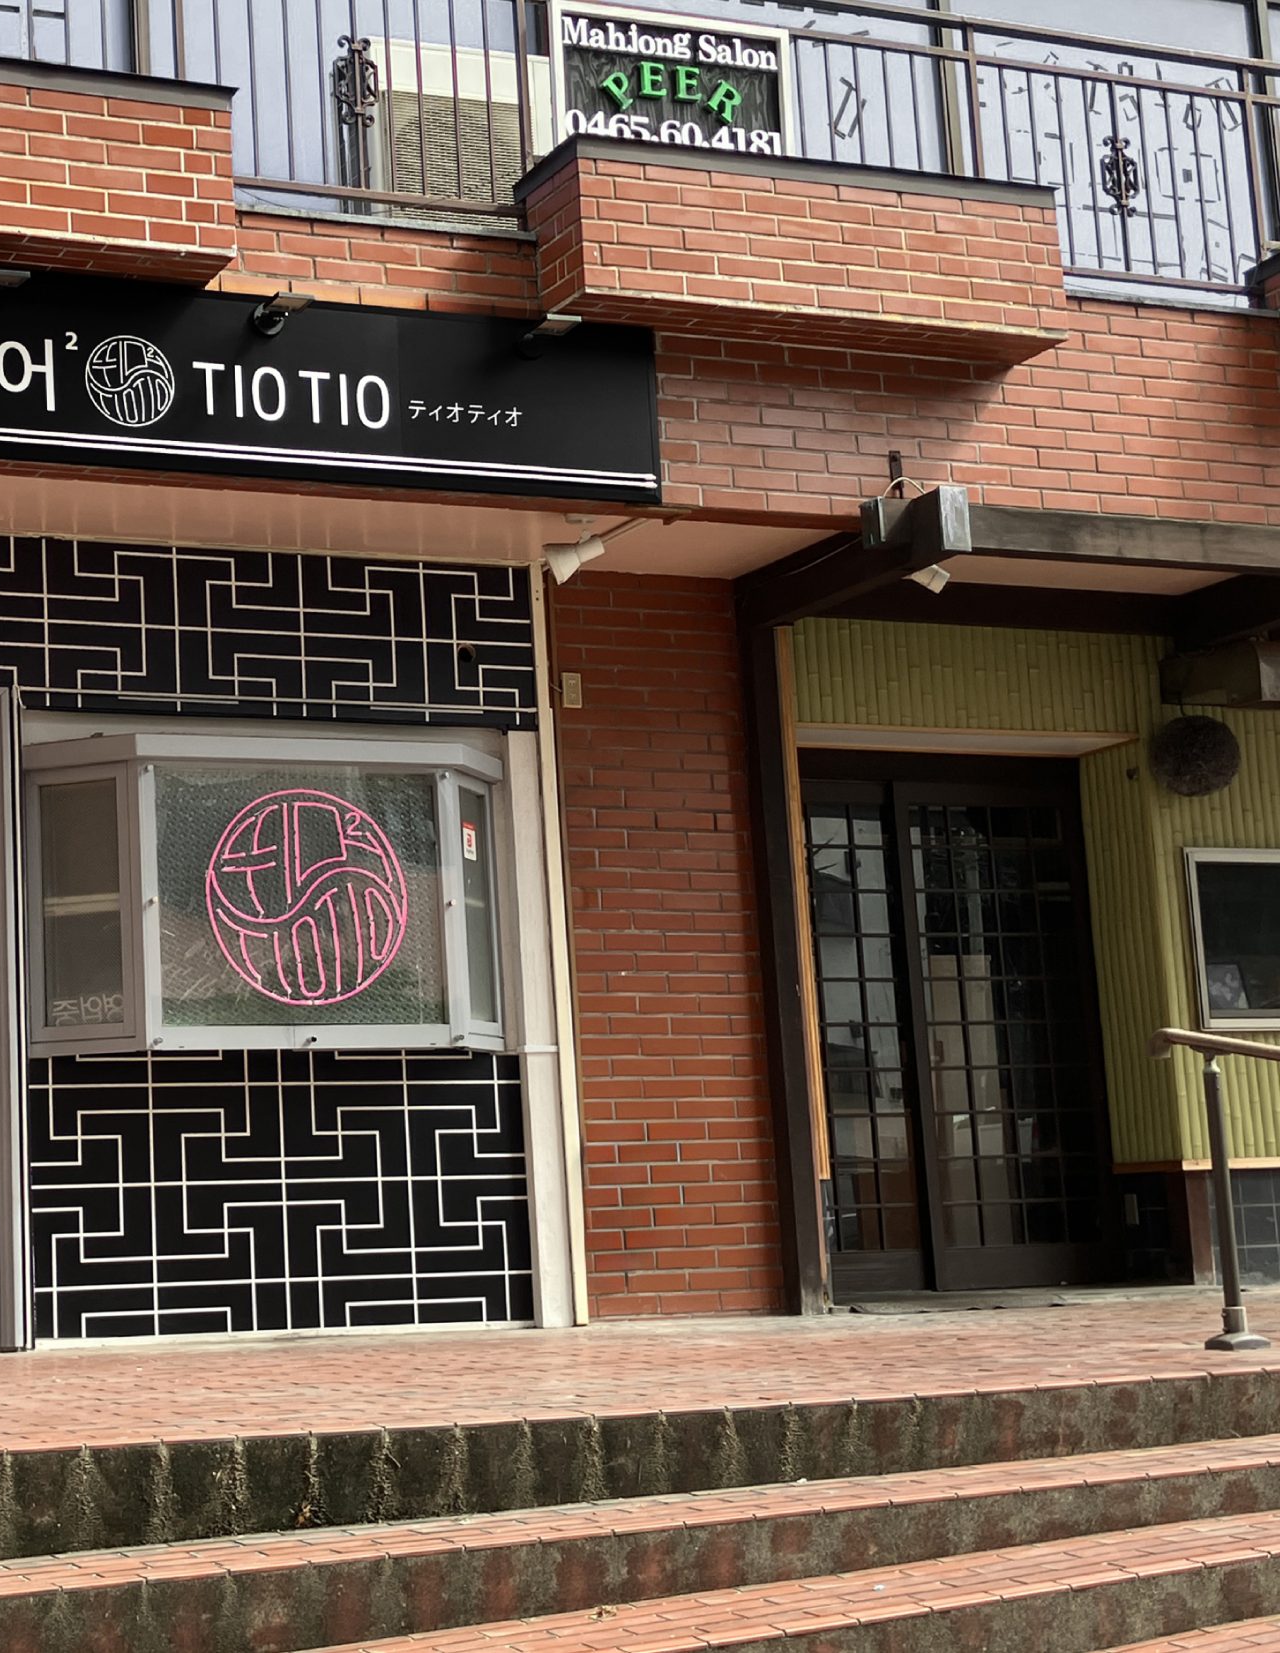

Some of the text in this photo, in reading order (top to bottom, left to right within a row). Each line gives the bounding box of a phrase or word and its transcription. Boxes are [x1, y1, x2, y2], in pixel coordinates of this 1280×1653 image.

[562, 15, 778, 70] Mahjong Salon
[601, 60, 743, 124] PEER
[565, 109, 782, 156] 0465.60.4181
[408, 400, 523, 427] ティオティオ
